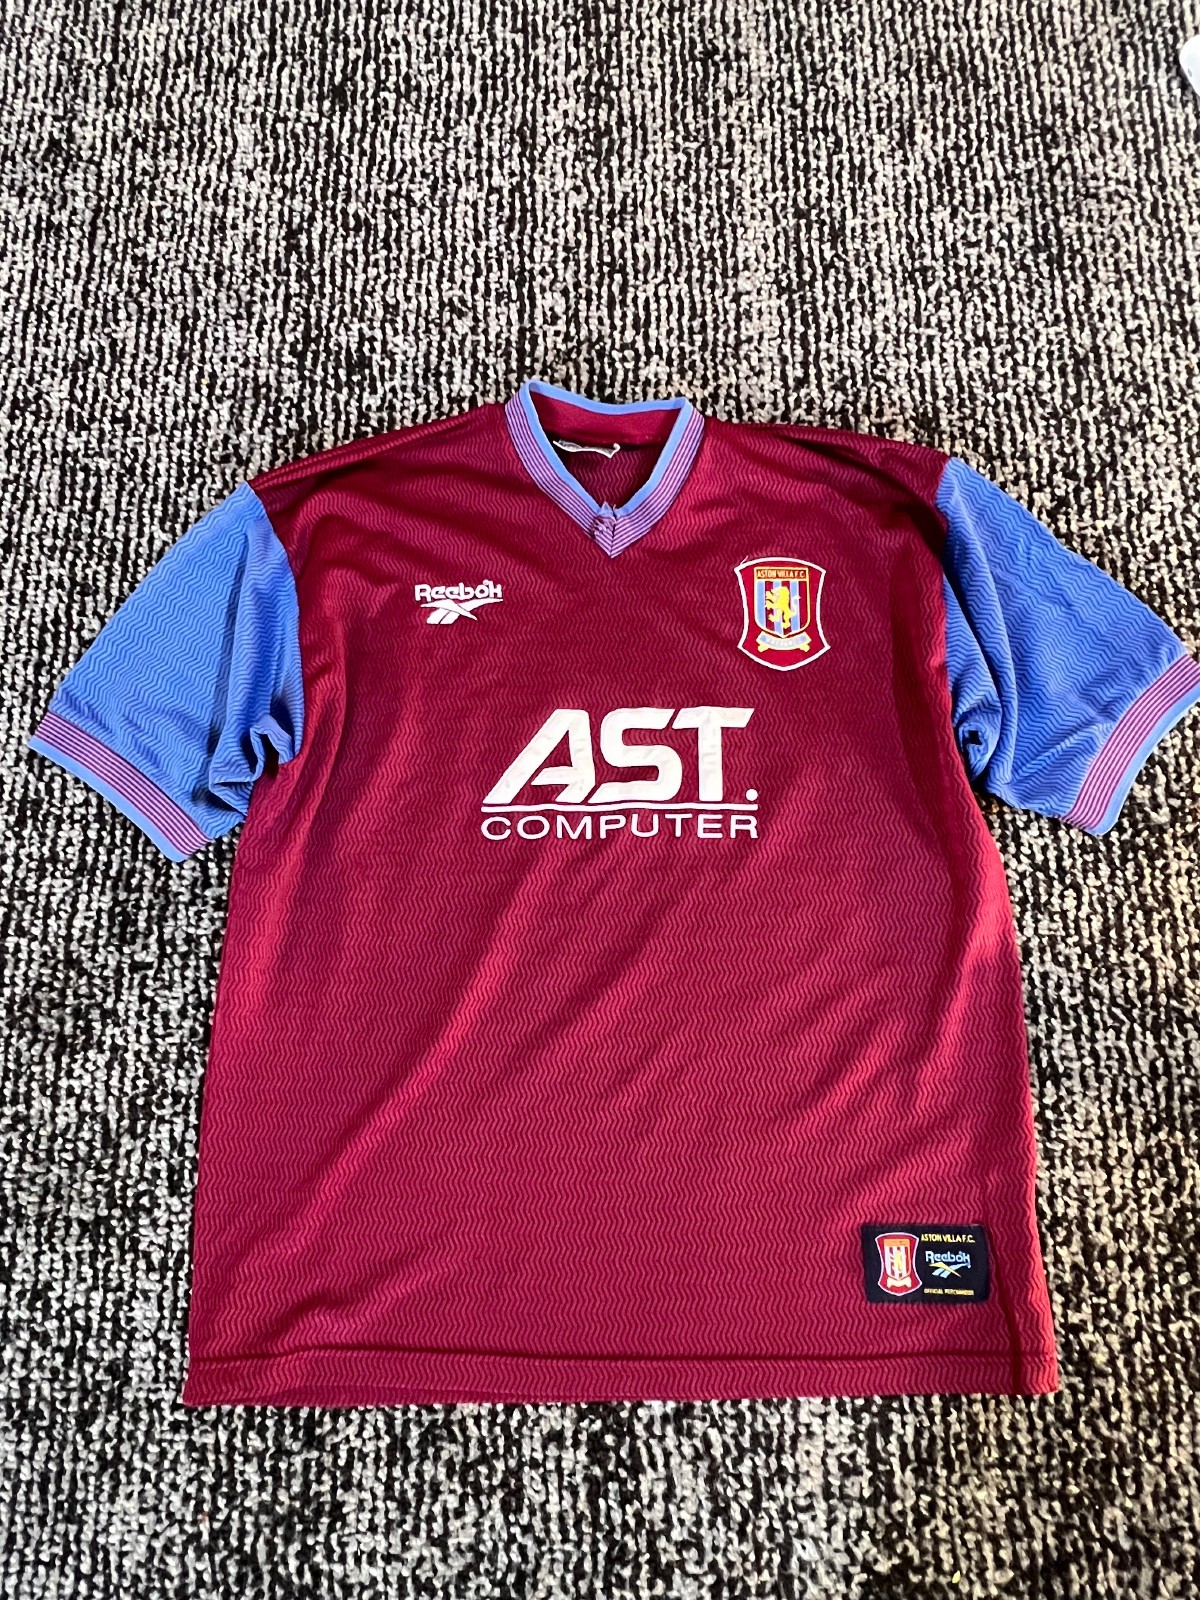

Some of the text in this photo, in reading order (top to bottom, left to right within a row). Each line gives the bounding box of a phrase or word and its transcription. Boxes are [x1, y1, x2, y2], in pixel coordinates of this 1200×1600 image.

[757, 570, 777, 578] ASTON
[777, 570, 794, 578] VILLA
[415, 579, 503, 602] Reebok
[481, 813, 758, 840] COMPUTER
[921, 1233, 942, 1242] ASTON
[943, 1234, 962, 1243] VILLA
[925, 1250, 971, 1266] Reebok
